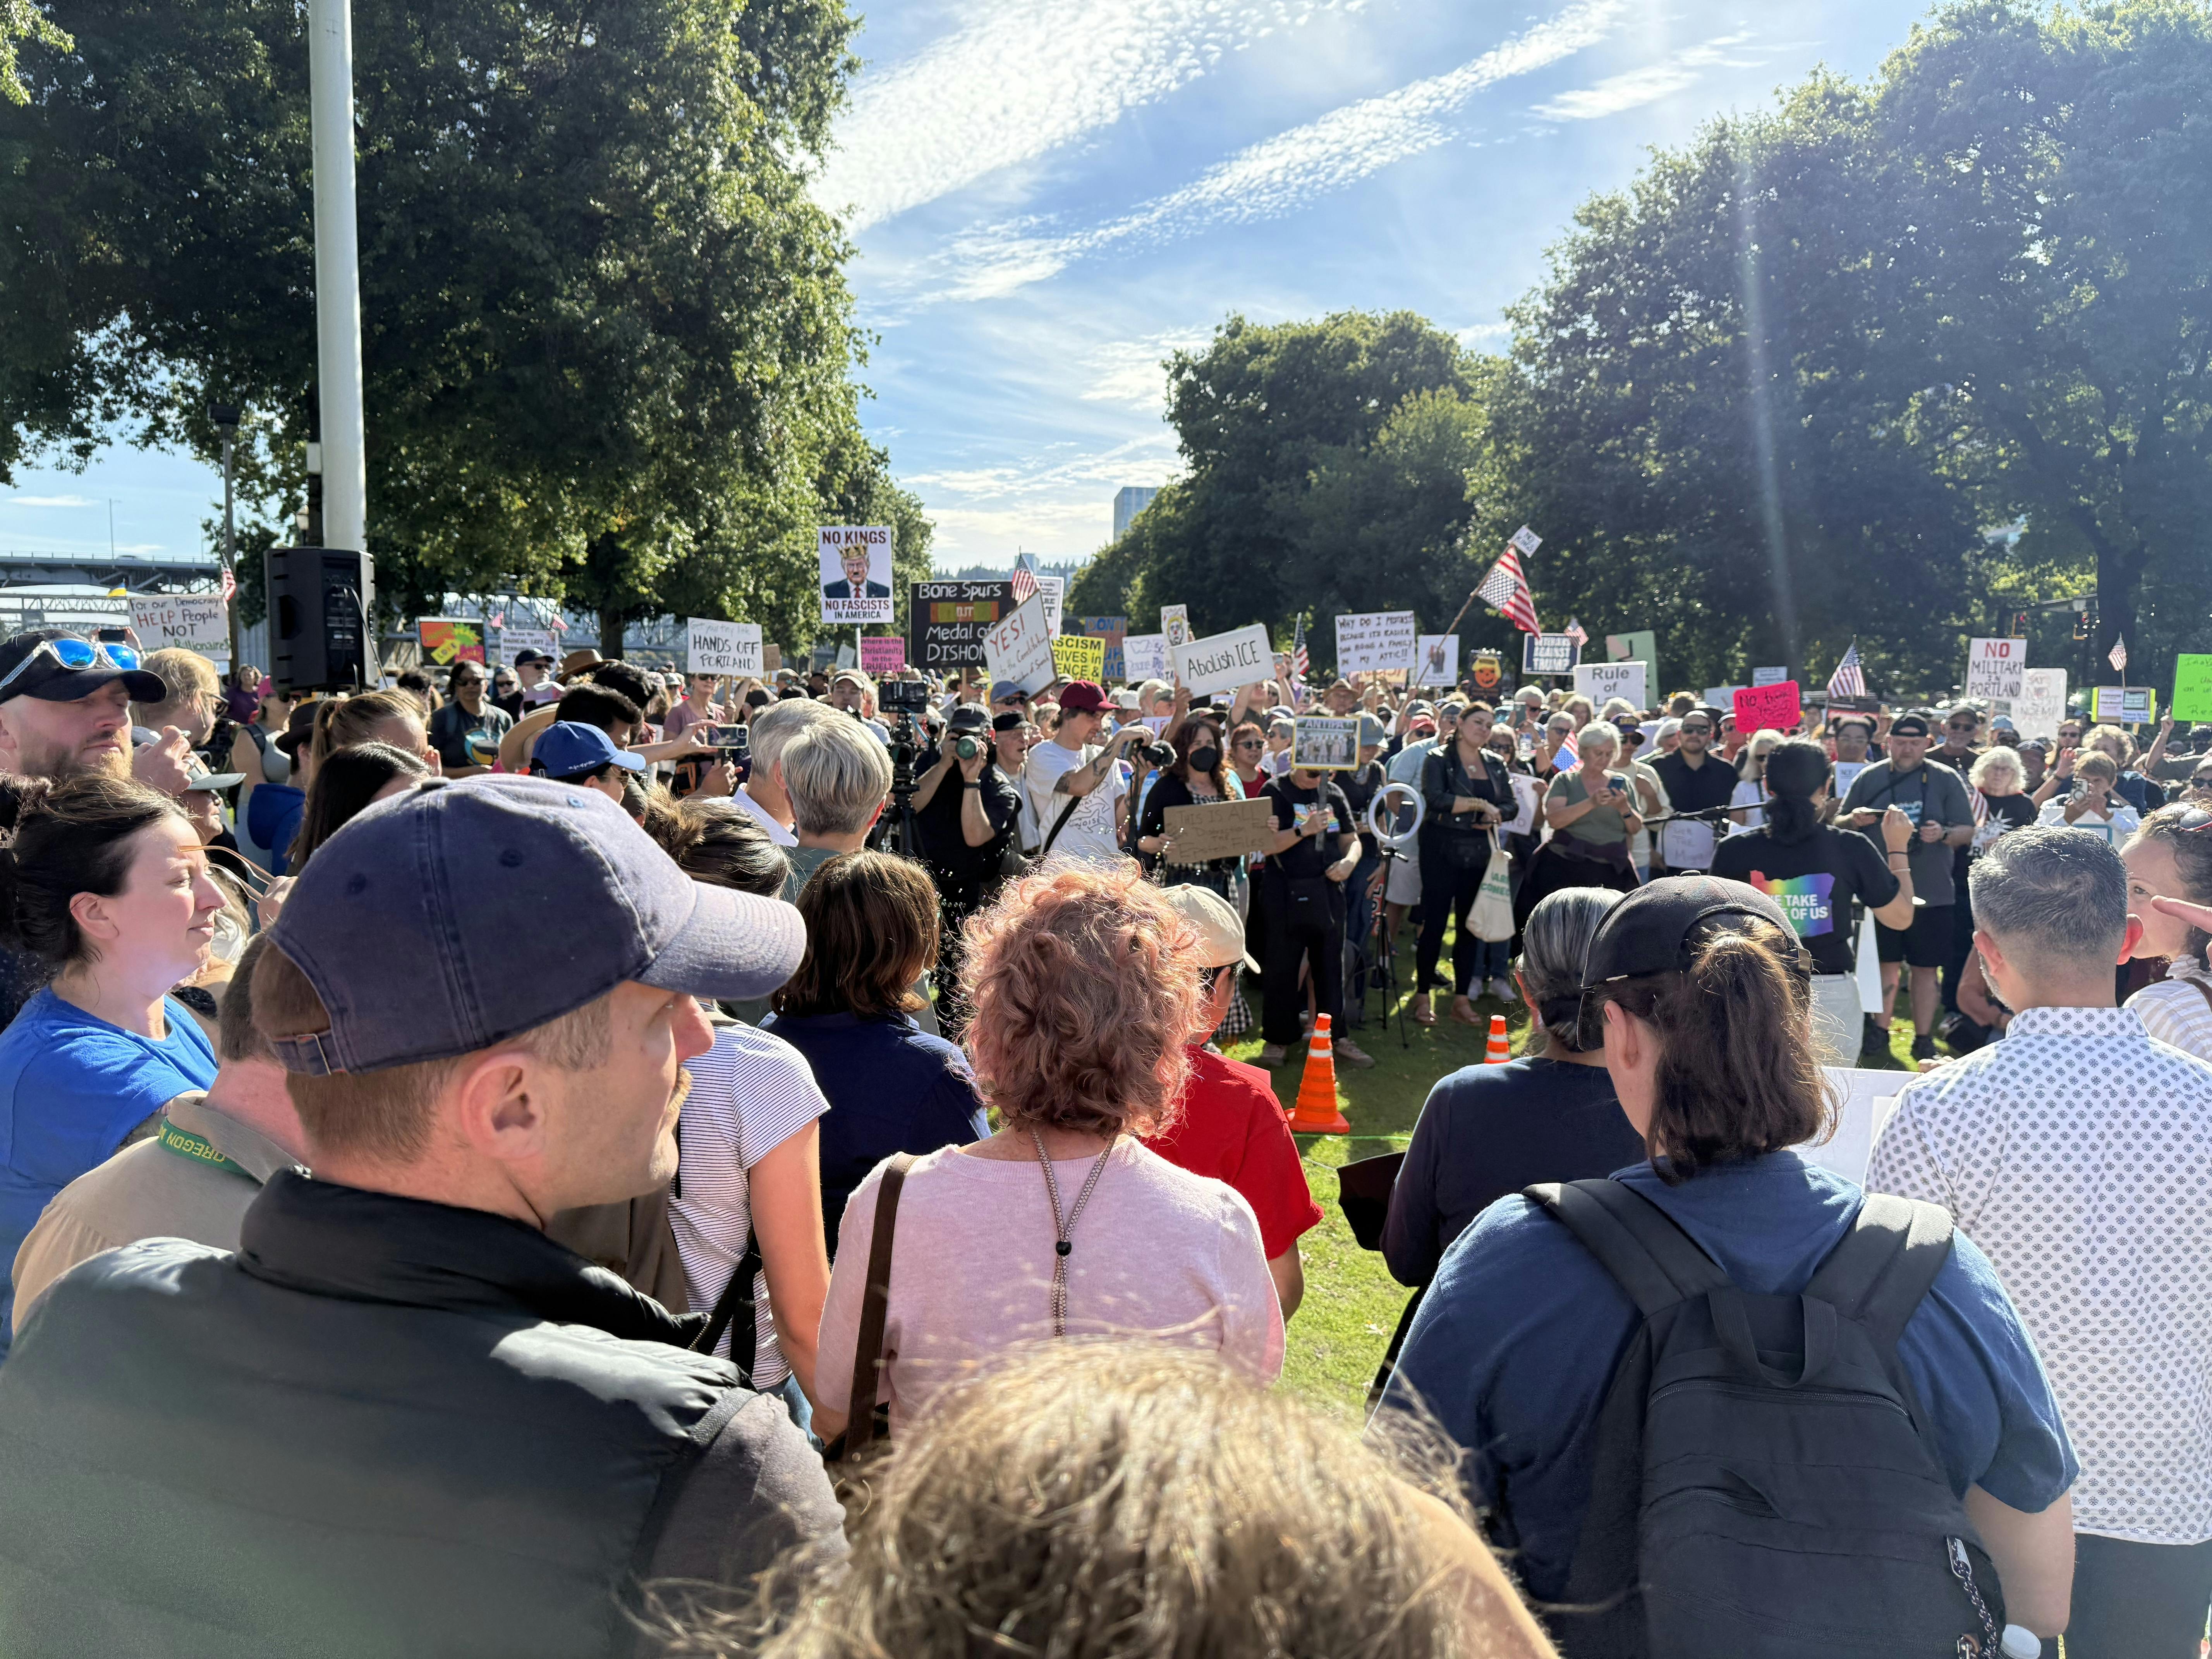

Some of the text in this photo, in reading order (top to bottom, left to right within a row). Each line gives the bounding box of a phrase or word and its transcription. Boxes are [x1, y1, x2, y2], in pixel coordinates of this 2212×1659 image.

[823, 531, 886, 544] NO KINGS
[919, 582, 1001, 601] Bone Spurs
[129, 598, 146, 611] For
[825, 600, 889, 610] NO FASCISTS
[956, 606, 974, 617] DJT
[137, 608, 218, 627] HELP People
[845, 611, 881, 619] AMERICA
[1359, 618, 1371, 627] DO
[1376, 617, 1381, 626] I
[163, 623, 197, 637] NOT
[925, 622, 996, 641] Medal of
[989, 613, 1025, 657] YES!
[693, 634, 760, 655] HANDS OFF
[1052, 637, 1101, 651] SCISM
[1985, 642, 2010, 658] NO
[926, 643, 986, 661] DISHON
[1054, 650, 1101, 665] RIVES in
[1235, 640, 1260, 666] ICE
[700, 653, 755, 670] PORTLAND
[1533, 658, 1570, 671] TRUMP
[1971, 660, 2024, 675] MILITARY
[1056, 663, 1099, 677] ENCE &
[1592, 667, 1629, 680] Rule
[1604, 682, 1617, 692] of
[1970, 681, 2021, 697] PORTLAND
[1176, 805, 1260, 825] THIS IS ALL
[1784, 894, 1818, 906] TAKE
[1790, 907, 1808, 920] OF
[1810, 906, 1828, 919] US
[167, 1132, 226, 1162] OREGON
